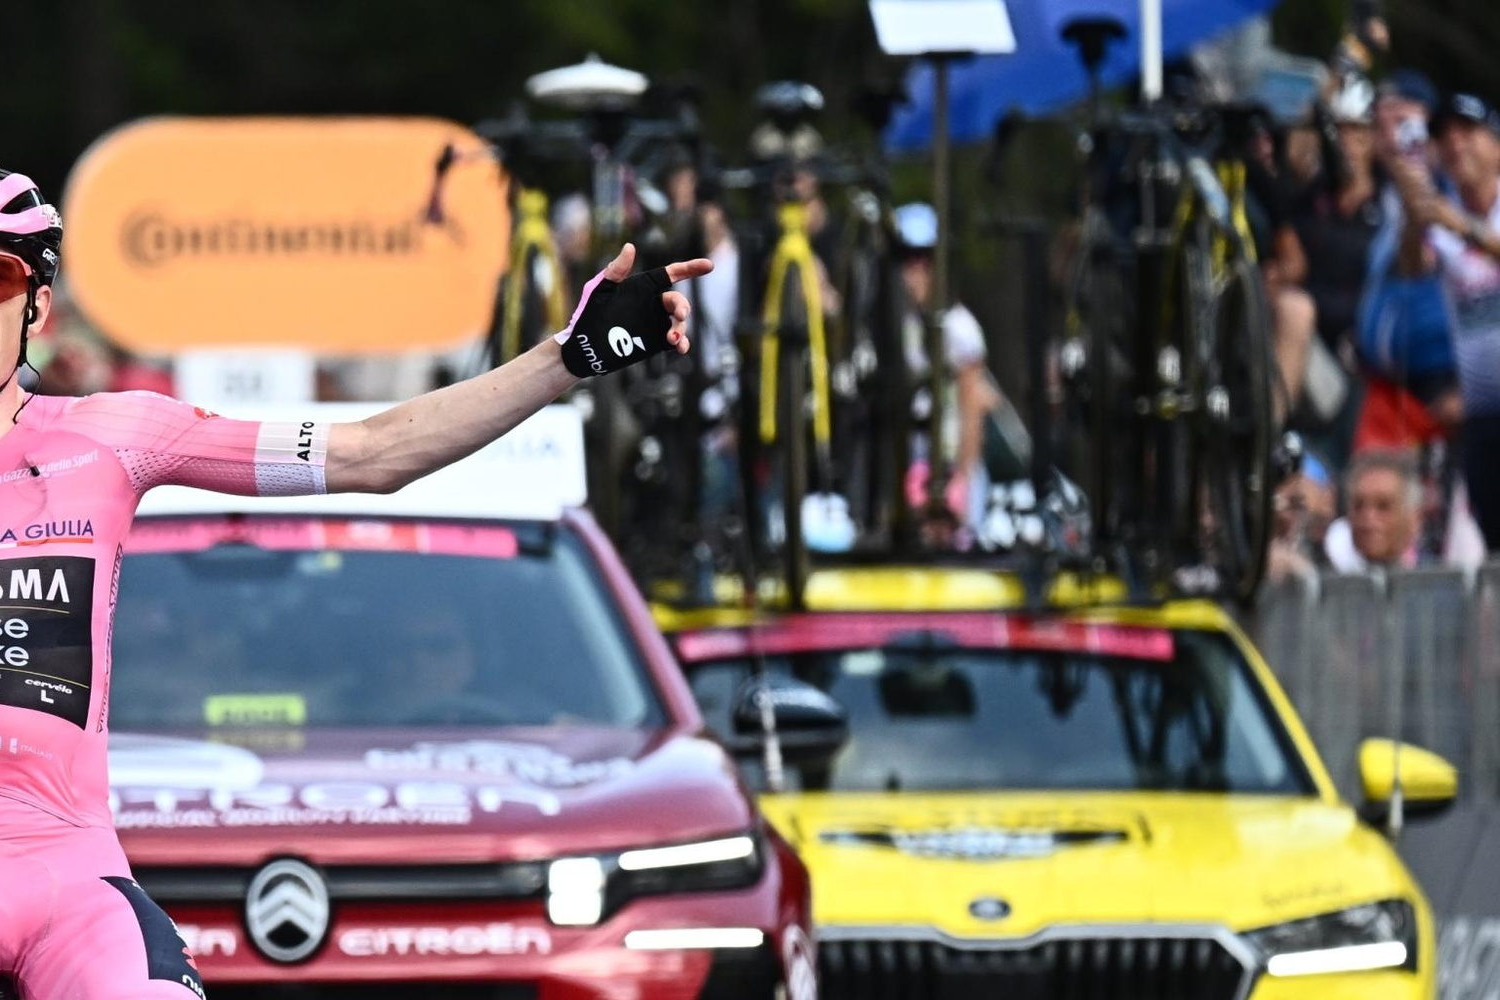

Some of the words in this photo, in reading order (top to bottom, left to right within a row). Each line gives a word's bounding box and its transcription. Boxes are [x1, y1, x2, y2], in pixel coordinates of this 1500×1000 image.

[577, 334, 608, 373] nimbl
[297, 421, 315, 462] ALTO
[25, 519, 94, 539] GIULIA
